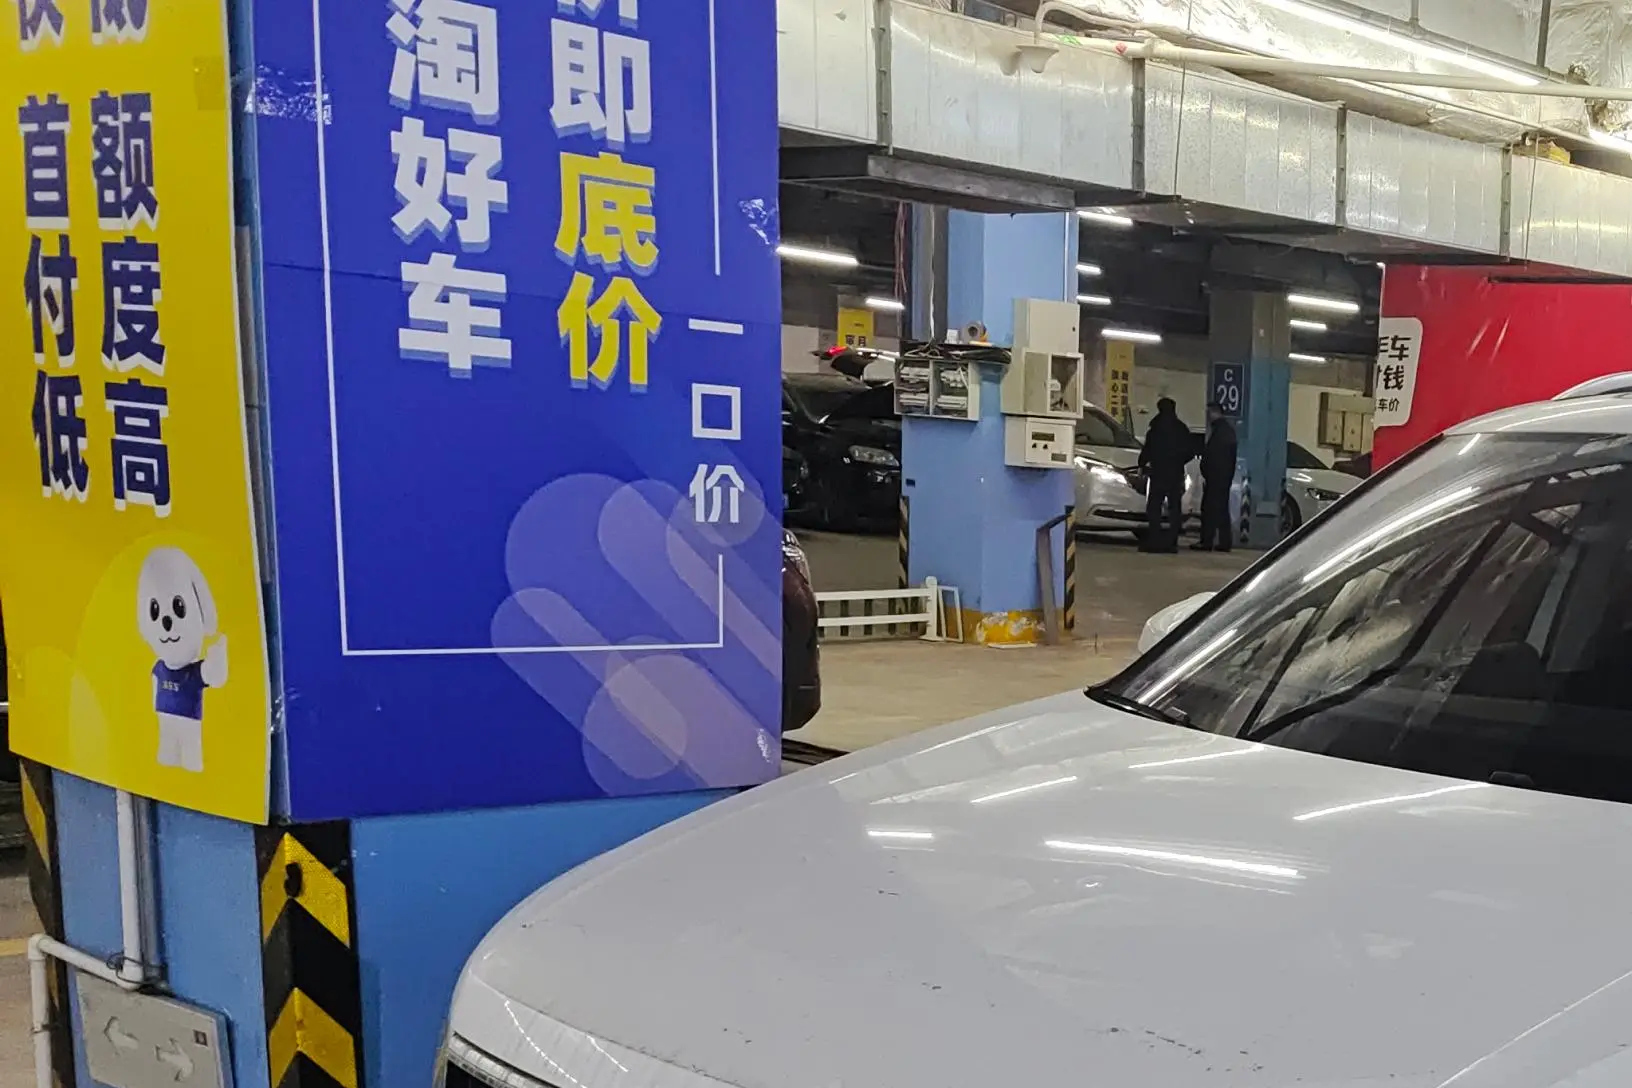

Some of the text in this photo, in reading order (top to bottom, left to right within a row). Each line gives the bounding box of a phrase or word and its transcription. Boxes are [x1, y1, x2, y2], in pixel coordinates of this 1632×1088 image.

[17, 93, 90, 501] 首付低
[90, 90, 172, 516] 额度高
[385, 0, 512, 378] 淘好车
[549, 0, 662, 388] 即底价
[688, 320, 744, 523] 一口价
[1217, 385, 1239, 411] 29
[1224, 369, 1234, 382] C
[1377, 364, 1404, 390] 钱
